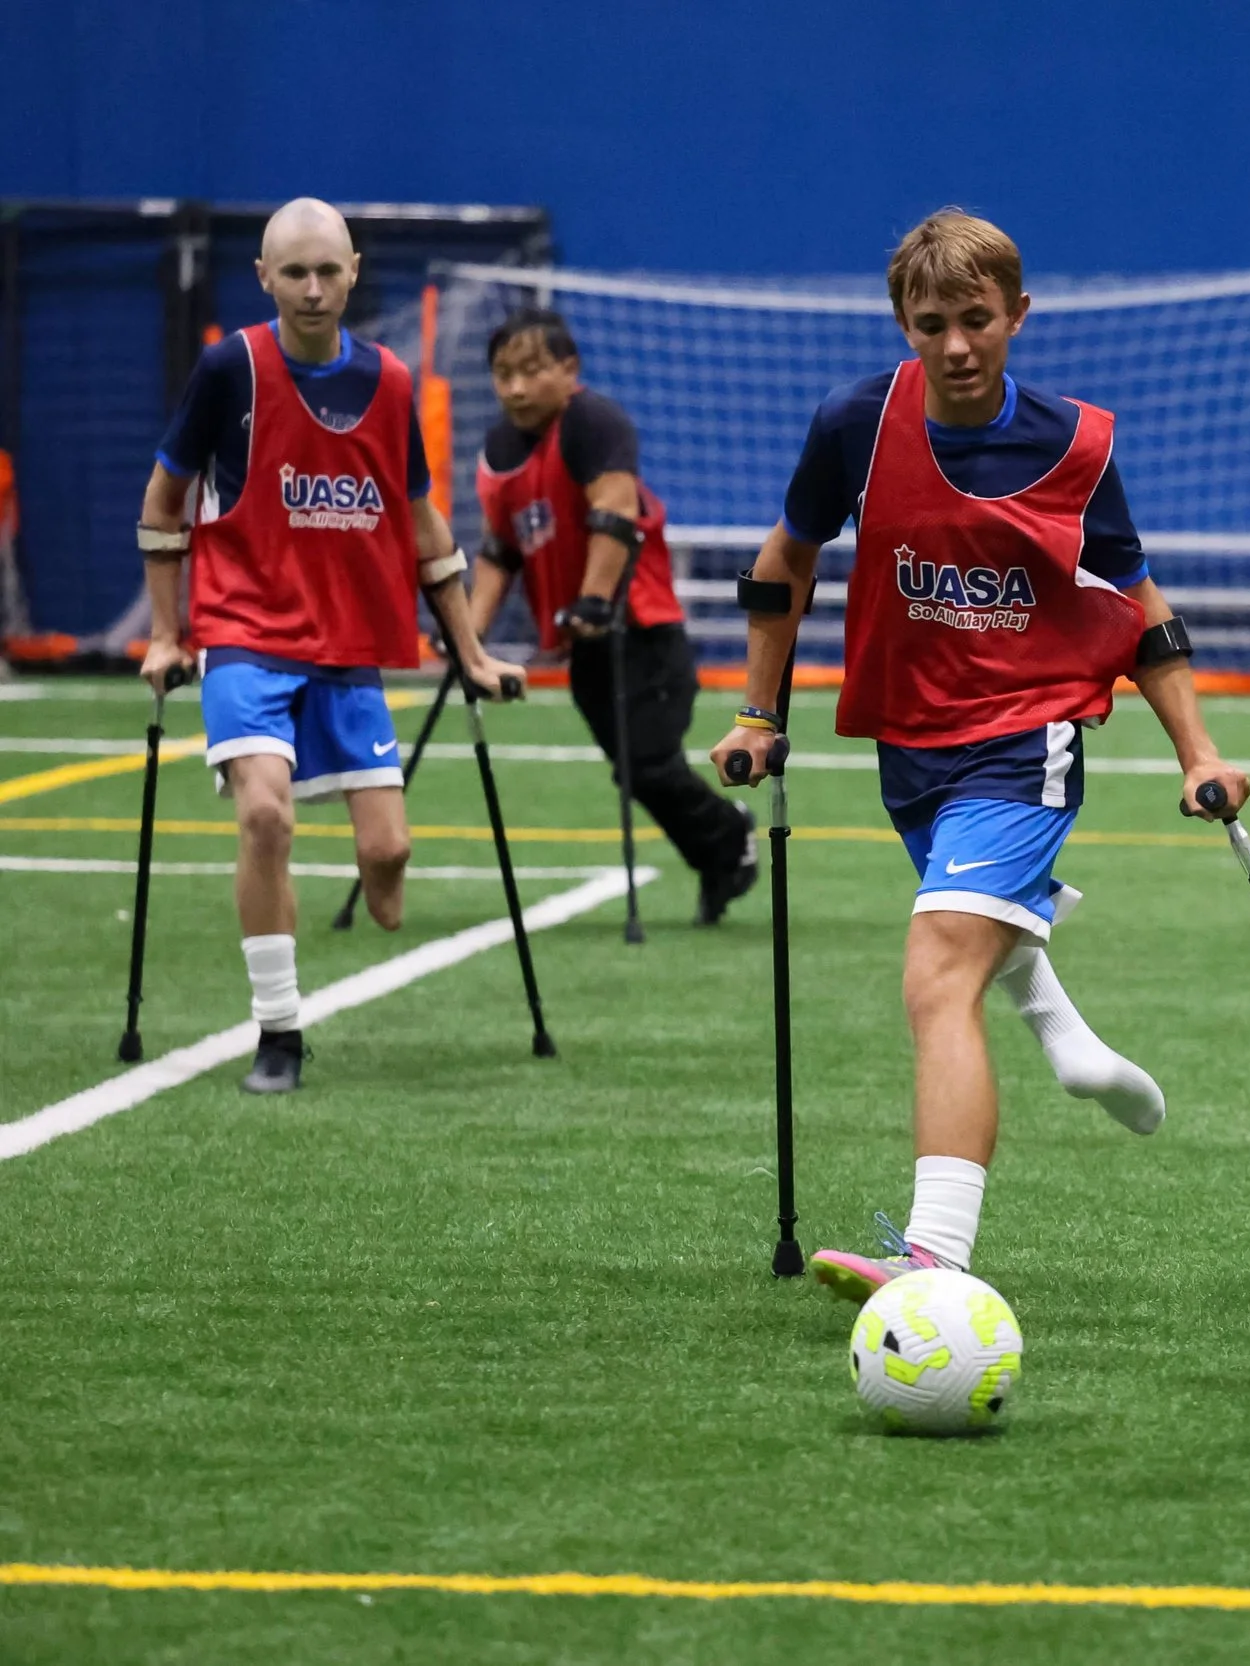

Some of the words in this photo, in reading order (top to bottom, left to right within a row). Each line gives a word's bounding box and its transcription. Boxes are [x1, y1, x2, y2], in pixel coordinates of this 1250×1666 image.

[281, 474, 384, 513] UASA
[897, 562, 1036, 608] UASA
[908, 603, 934, 619] So
[934, 606, 956, 626] All
[955, 611, 991, 632] May
[992, 610, 1030, 632] Play
